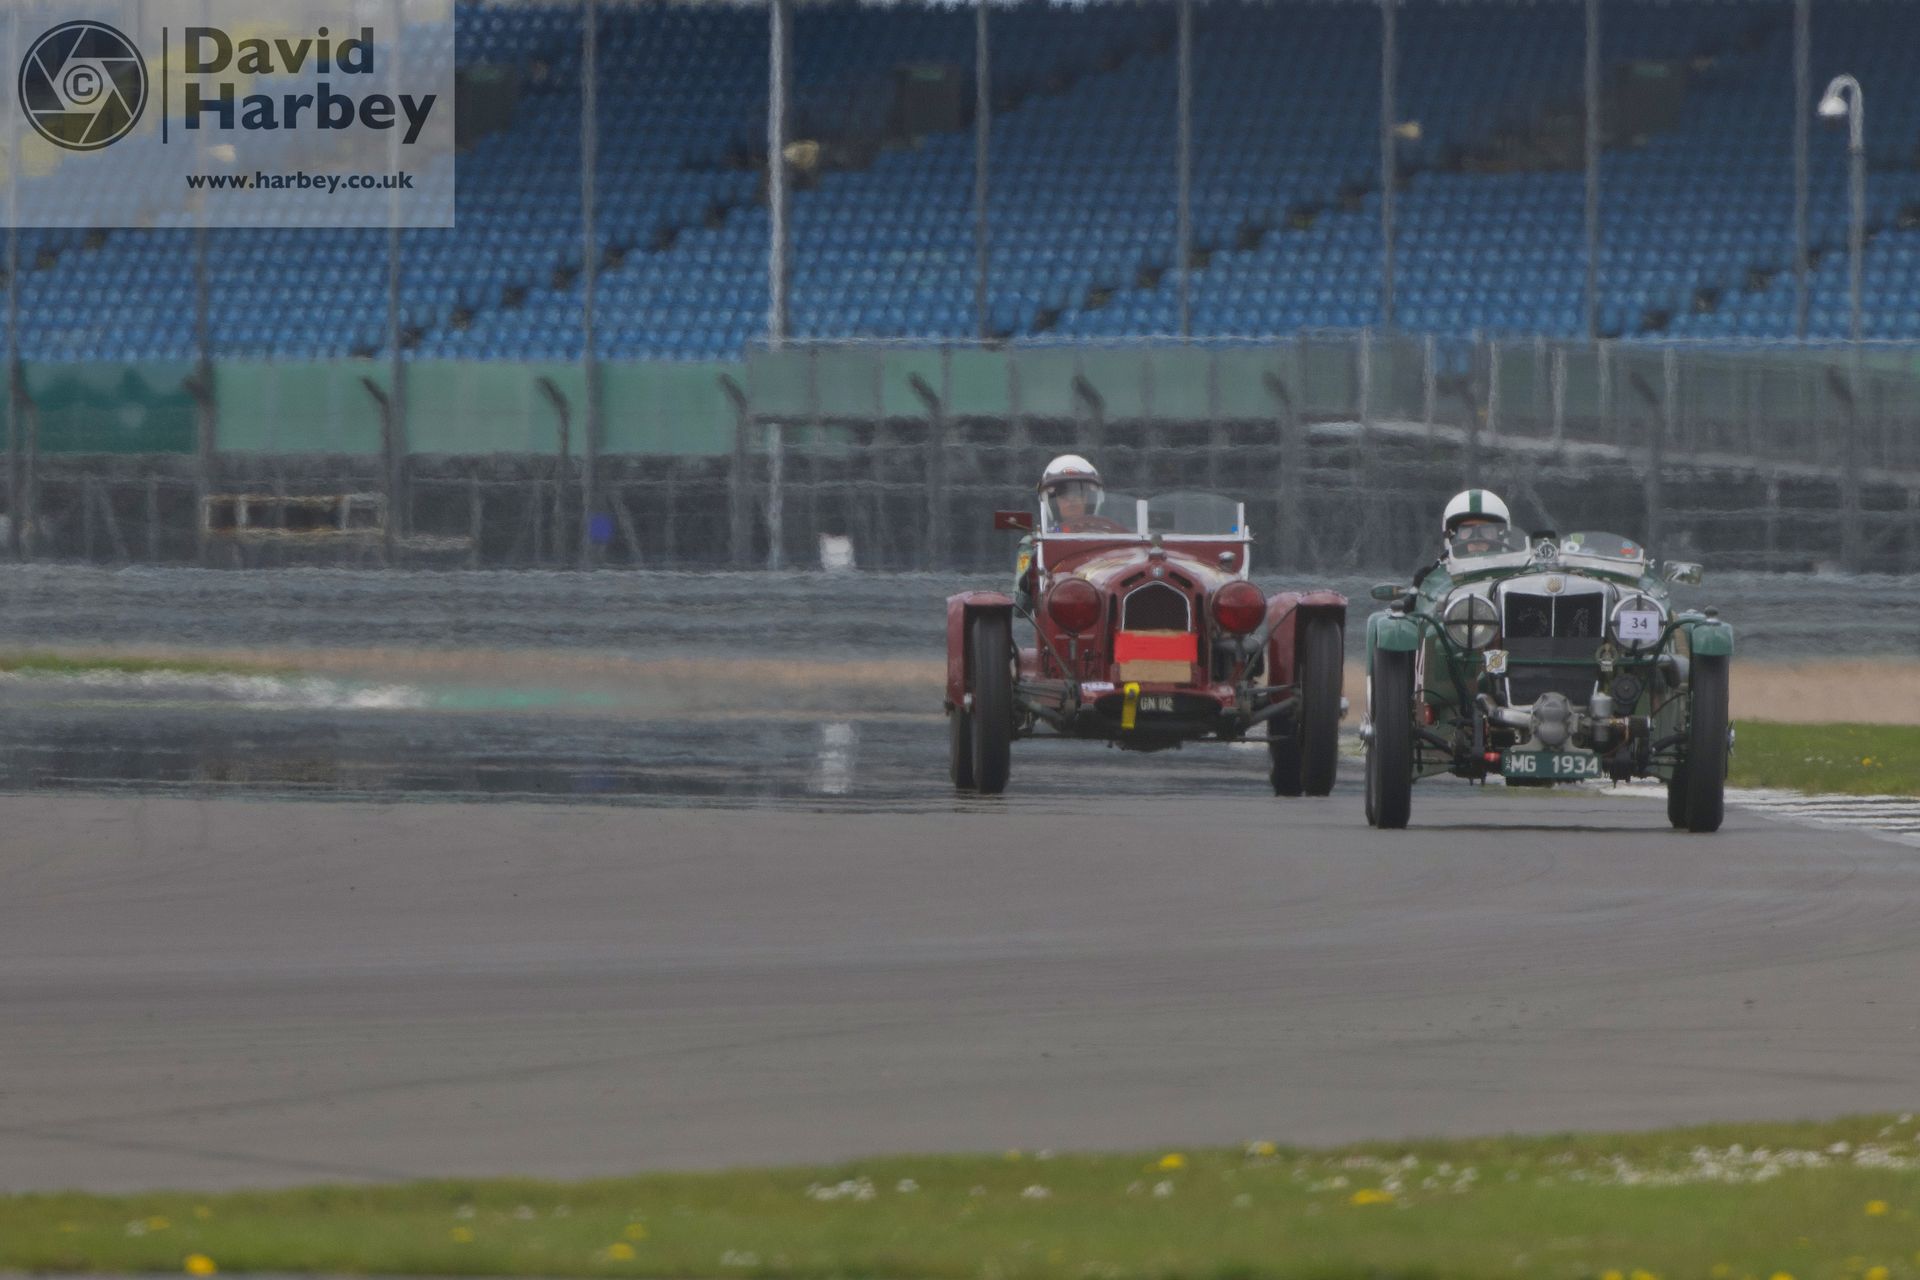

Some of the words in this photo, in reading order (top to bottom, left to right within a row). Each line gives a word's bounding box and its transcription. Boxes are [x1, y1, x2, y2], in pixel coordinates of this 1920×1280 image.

[1631, 617, 1647, 629] 34
[1511, 755, 1536, 772] MG
[1552, 755, 1598, 773] 1934
